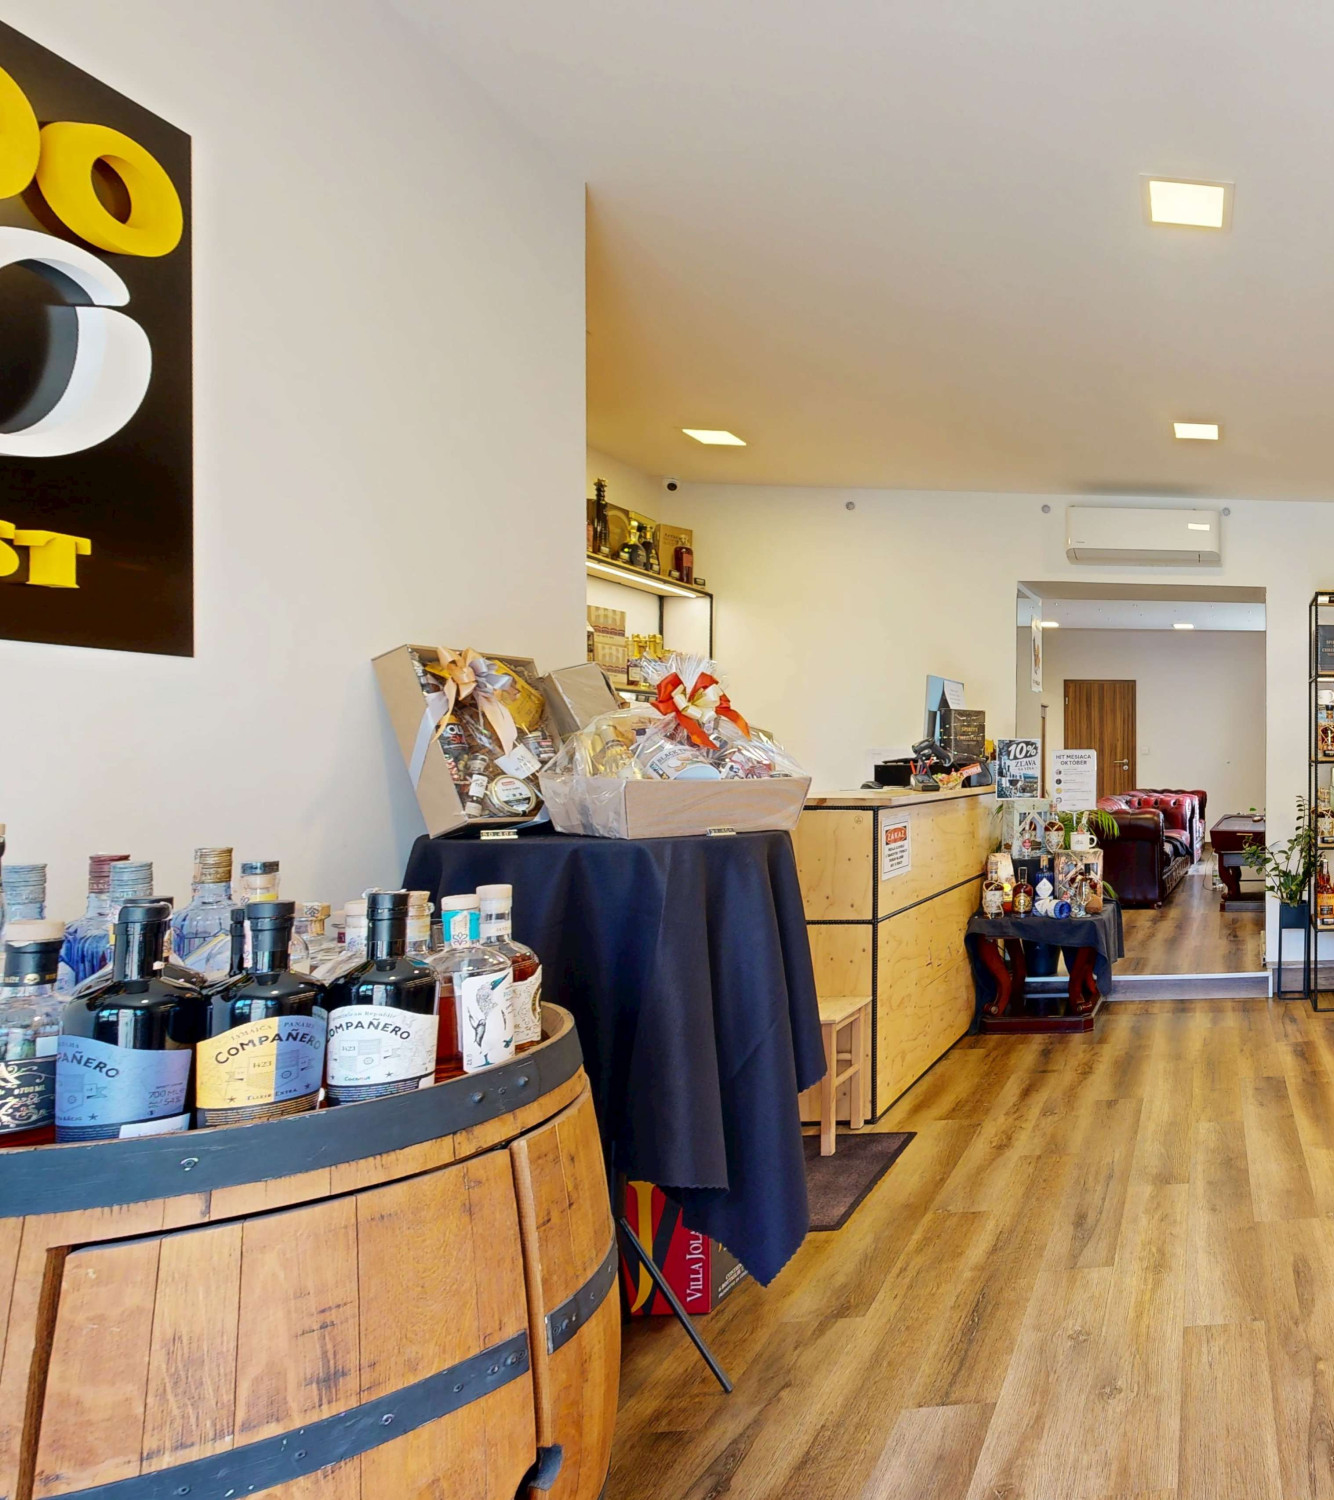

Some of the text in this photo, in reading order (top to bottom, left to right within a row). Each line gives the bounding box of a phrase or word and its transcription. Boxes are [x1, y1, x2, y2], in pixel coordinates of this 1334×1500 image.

[657, 748, 680, 764] BLACK
[1007, 742, 1037, 761] 10%
[214, 1028, 321, 1065] COMPAÑERO
[686, 1263, 703, 1303] VILLA
